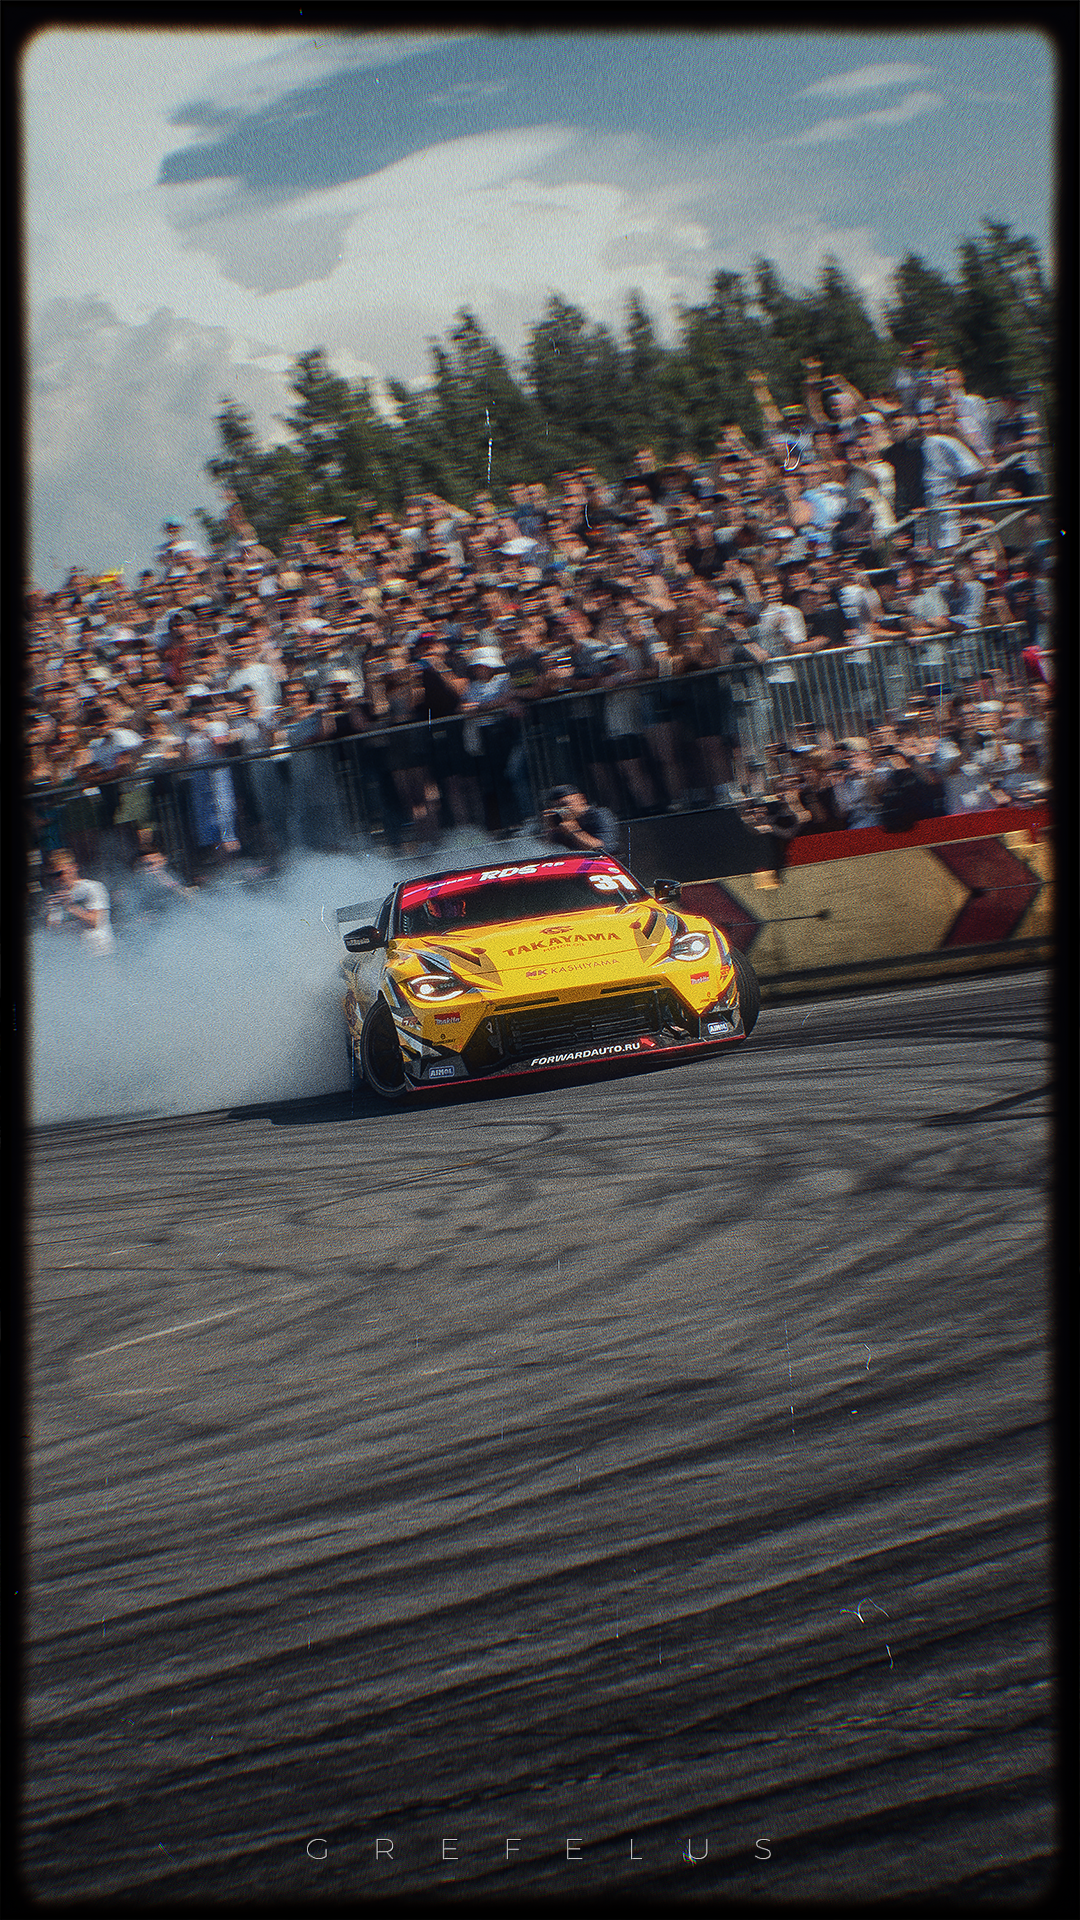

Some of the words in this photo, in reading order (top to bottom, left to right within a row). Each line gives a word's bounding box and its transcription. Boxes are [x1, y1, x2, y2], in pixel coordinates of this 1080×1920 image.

[479, 864, 540, 881] RDS
[589, 874, 637, 890] 31
[502, 932, 621, 956] TAKAYAMA
[543, 942, 571, 952] MOTOR
[551, 958, 620, 974] KASHIYAMA
[530, 1042, 641, 1067] FORWARDAUTO.RU
